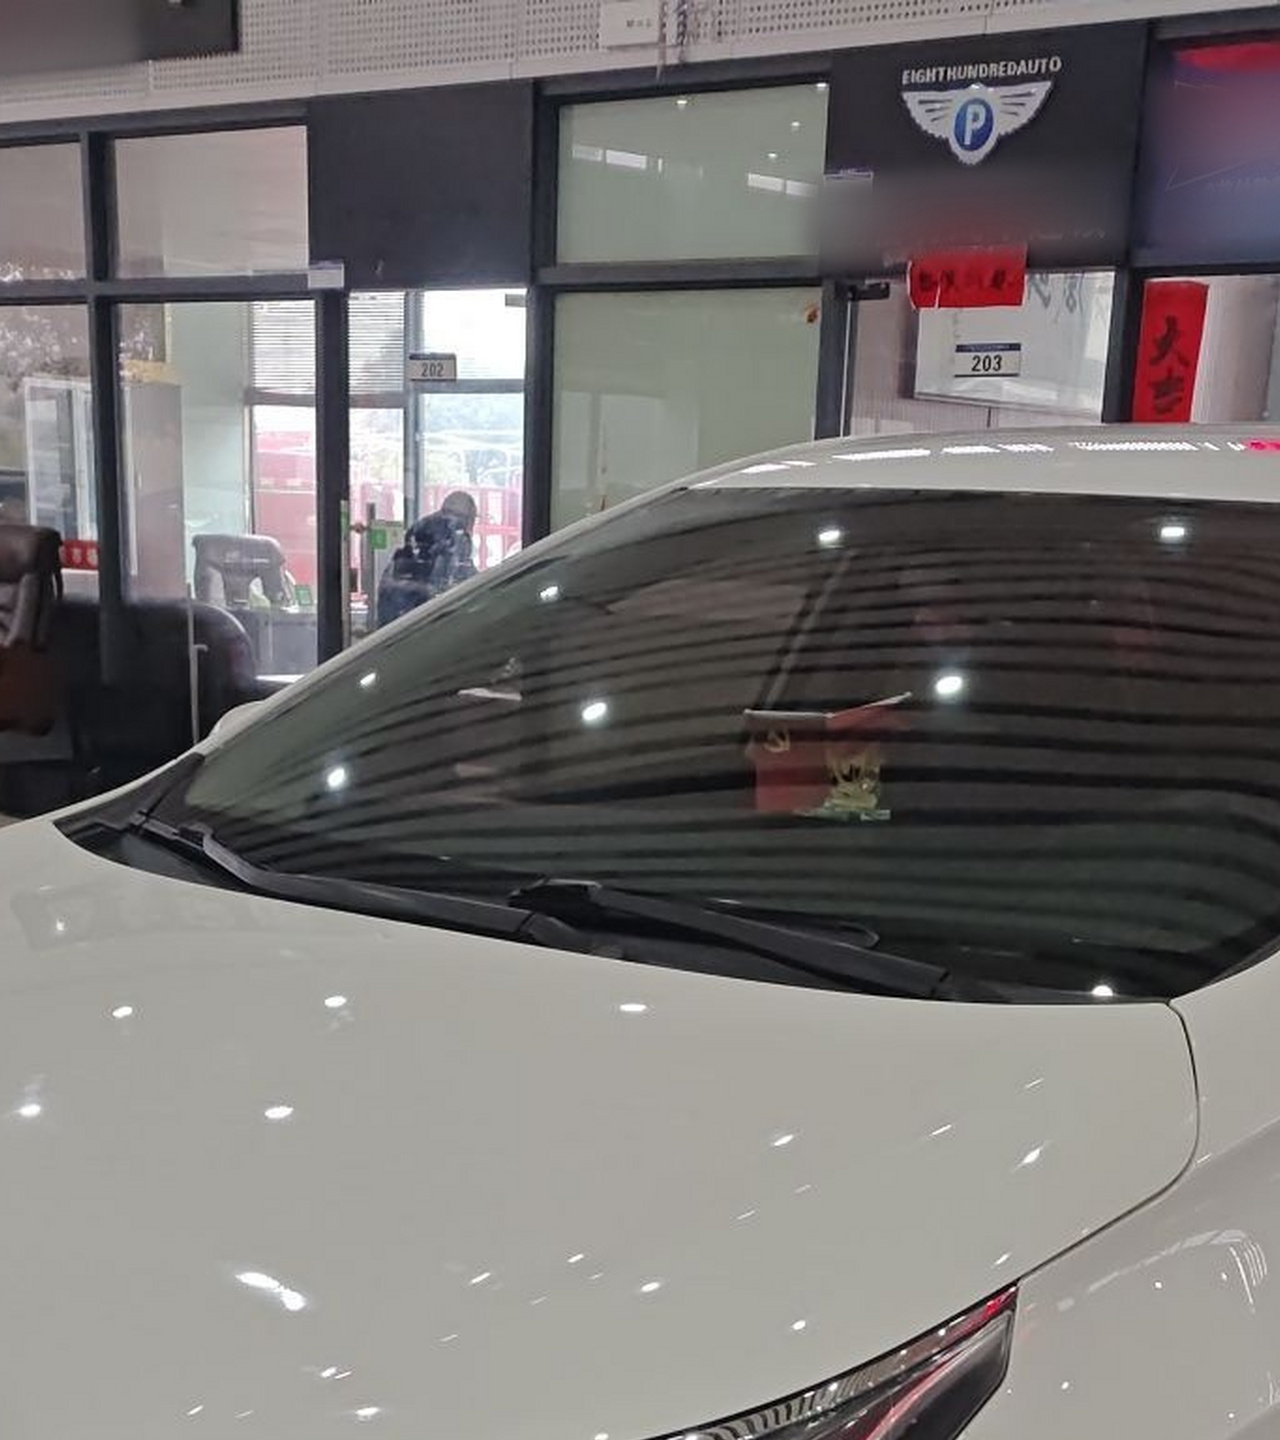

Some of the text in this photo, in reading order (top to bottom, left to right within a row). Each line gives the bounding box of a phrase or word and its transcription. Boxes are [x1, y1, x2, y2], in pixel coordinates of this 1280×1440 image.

[901, 55, 1063, 86] EIGHTHUNDREDAUTO
[963, 103, 987, 146] P
[421, 361, 444, 378] 202
[970, 354, 1003, 373] 203
